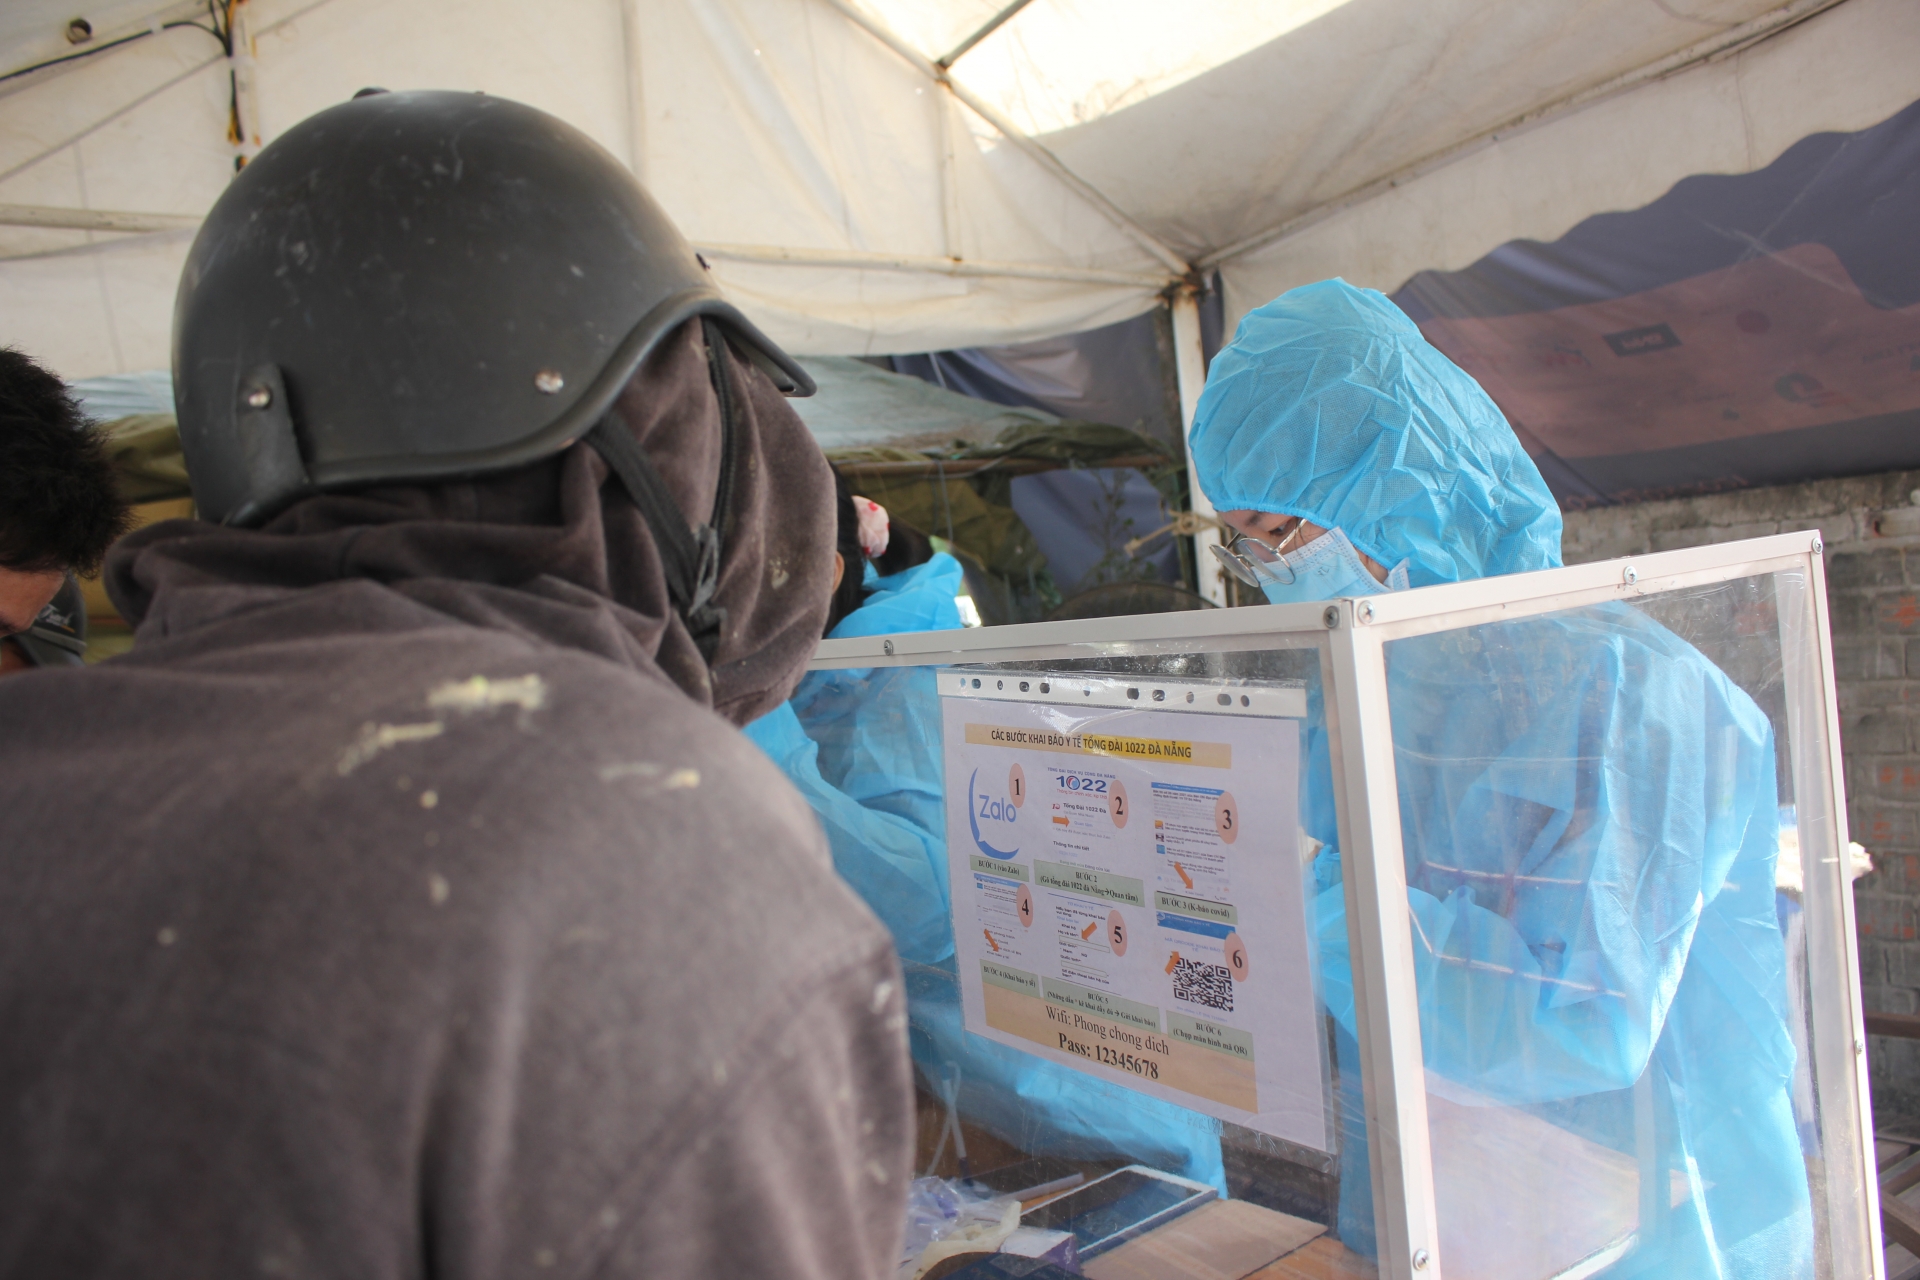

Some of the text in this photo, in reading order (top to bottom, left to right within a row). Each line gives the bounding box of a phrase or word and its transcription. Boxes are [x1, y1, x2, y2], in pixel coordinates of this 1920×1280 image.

[991, 728, 1192, 759] CÁC BƯỚC KHAI BÁO Y TẾ TỔNG ĐÀI 1022 ĐÀ NẴNG
[1014, 778, 1021, 796] 1
[1056, 775, 1107, 793] 1022
[979, 794, 1017, 823] Zalo
[1114, 795, 1124, 815] 2
[1222, 809, 1233, 830] 3
[1021, 898, 1030, 916] 4
[1161, 896, 1181, 908] BƯỚC
[1182, 901, 1187, 909] 3
[1210, 908, 1230, 919] covid)
[1113, 925, 1123, 944] 5
[1232, 949, 1243, 969] 6
[1045, 1005, 1170, 1056] Wifi: Phong chong dich
[1195, 1022, 1222, 1037] BƯỚC 6
[1058, 1032, 1159, 1079] Pass: 12345678
[1233, 1044, 1248, 1056] QR)
